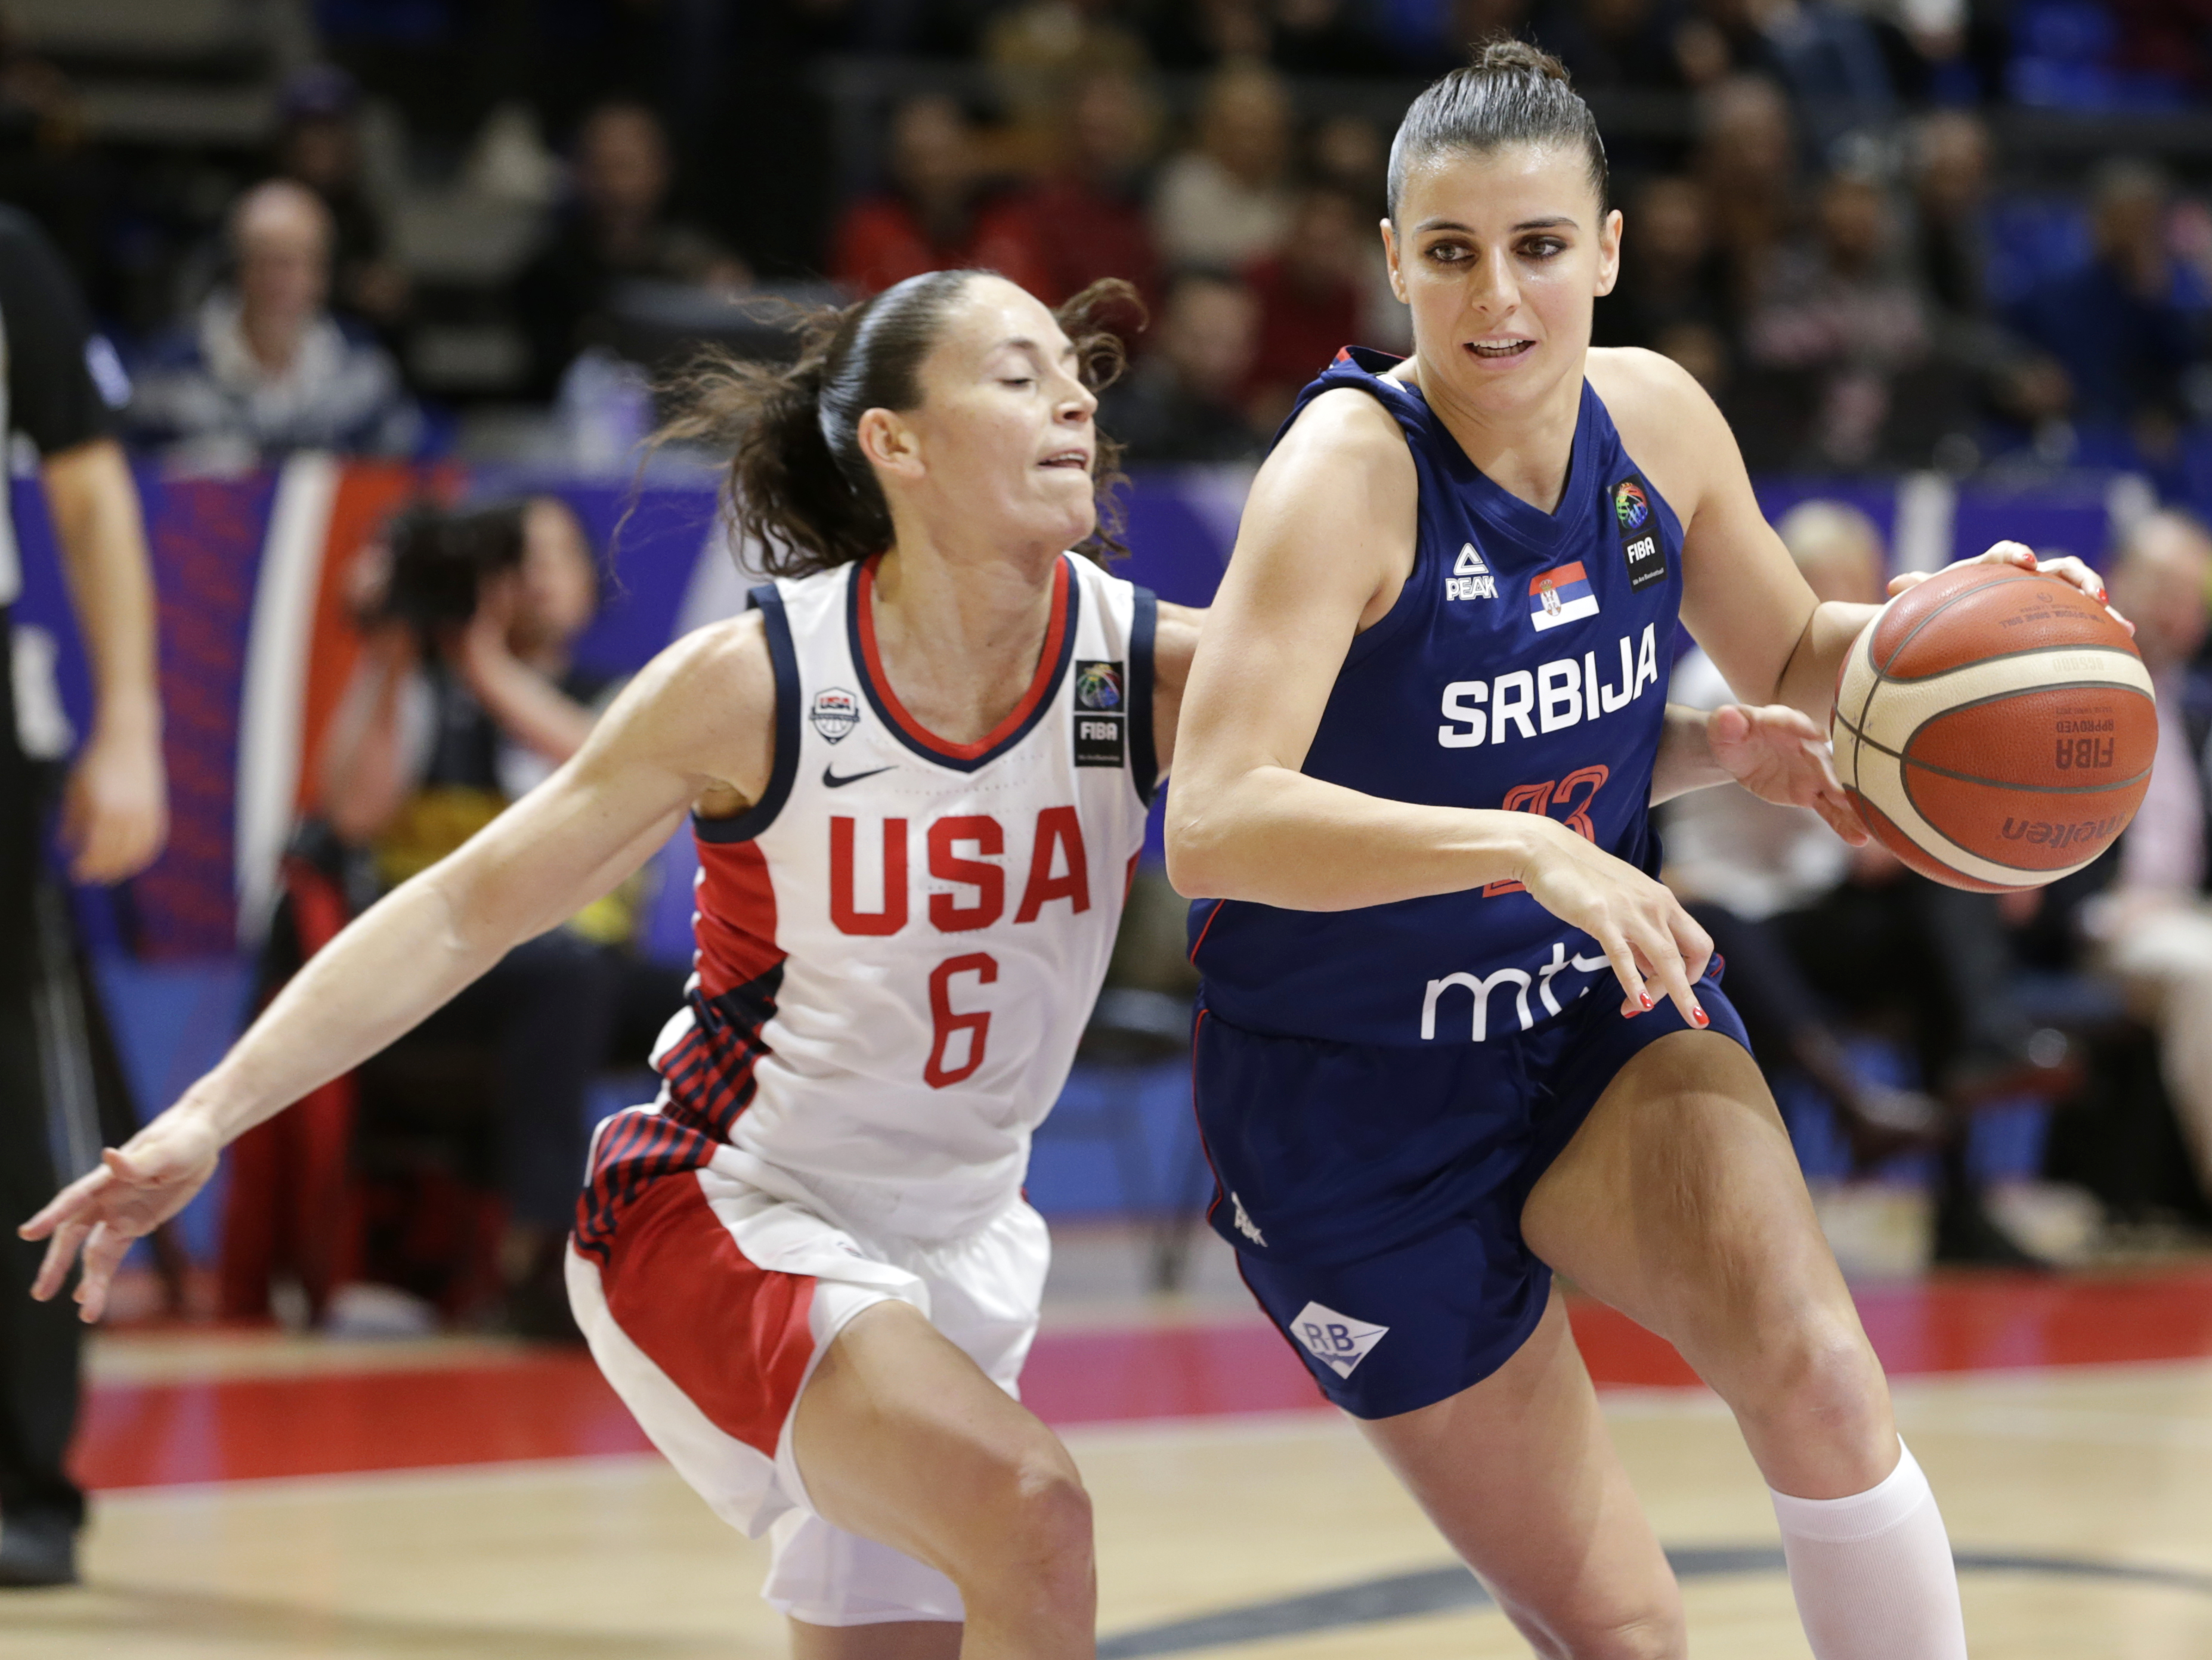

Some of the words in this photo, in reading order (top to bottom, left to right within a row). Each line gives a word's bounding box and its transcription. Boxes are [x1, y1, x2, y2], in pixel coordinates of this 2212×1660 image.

[1627, 537, 1656, 564] FIBA
[1445, 575, 1499, 602] PEAK
[1438, 622, 1658, 748] SRBIJA
[1079, 721, 1118, 741] FIBA
[2056, 718, 2114, 733] APPROVED
[2056, 737, 2114, 770] FIBA
[2001, 812, 2126, 848] molten
[830, 805, 1090, 937] USA
[923, 951, 999, 1091] 6
[1302, 1321, 1354, 1352] RB
